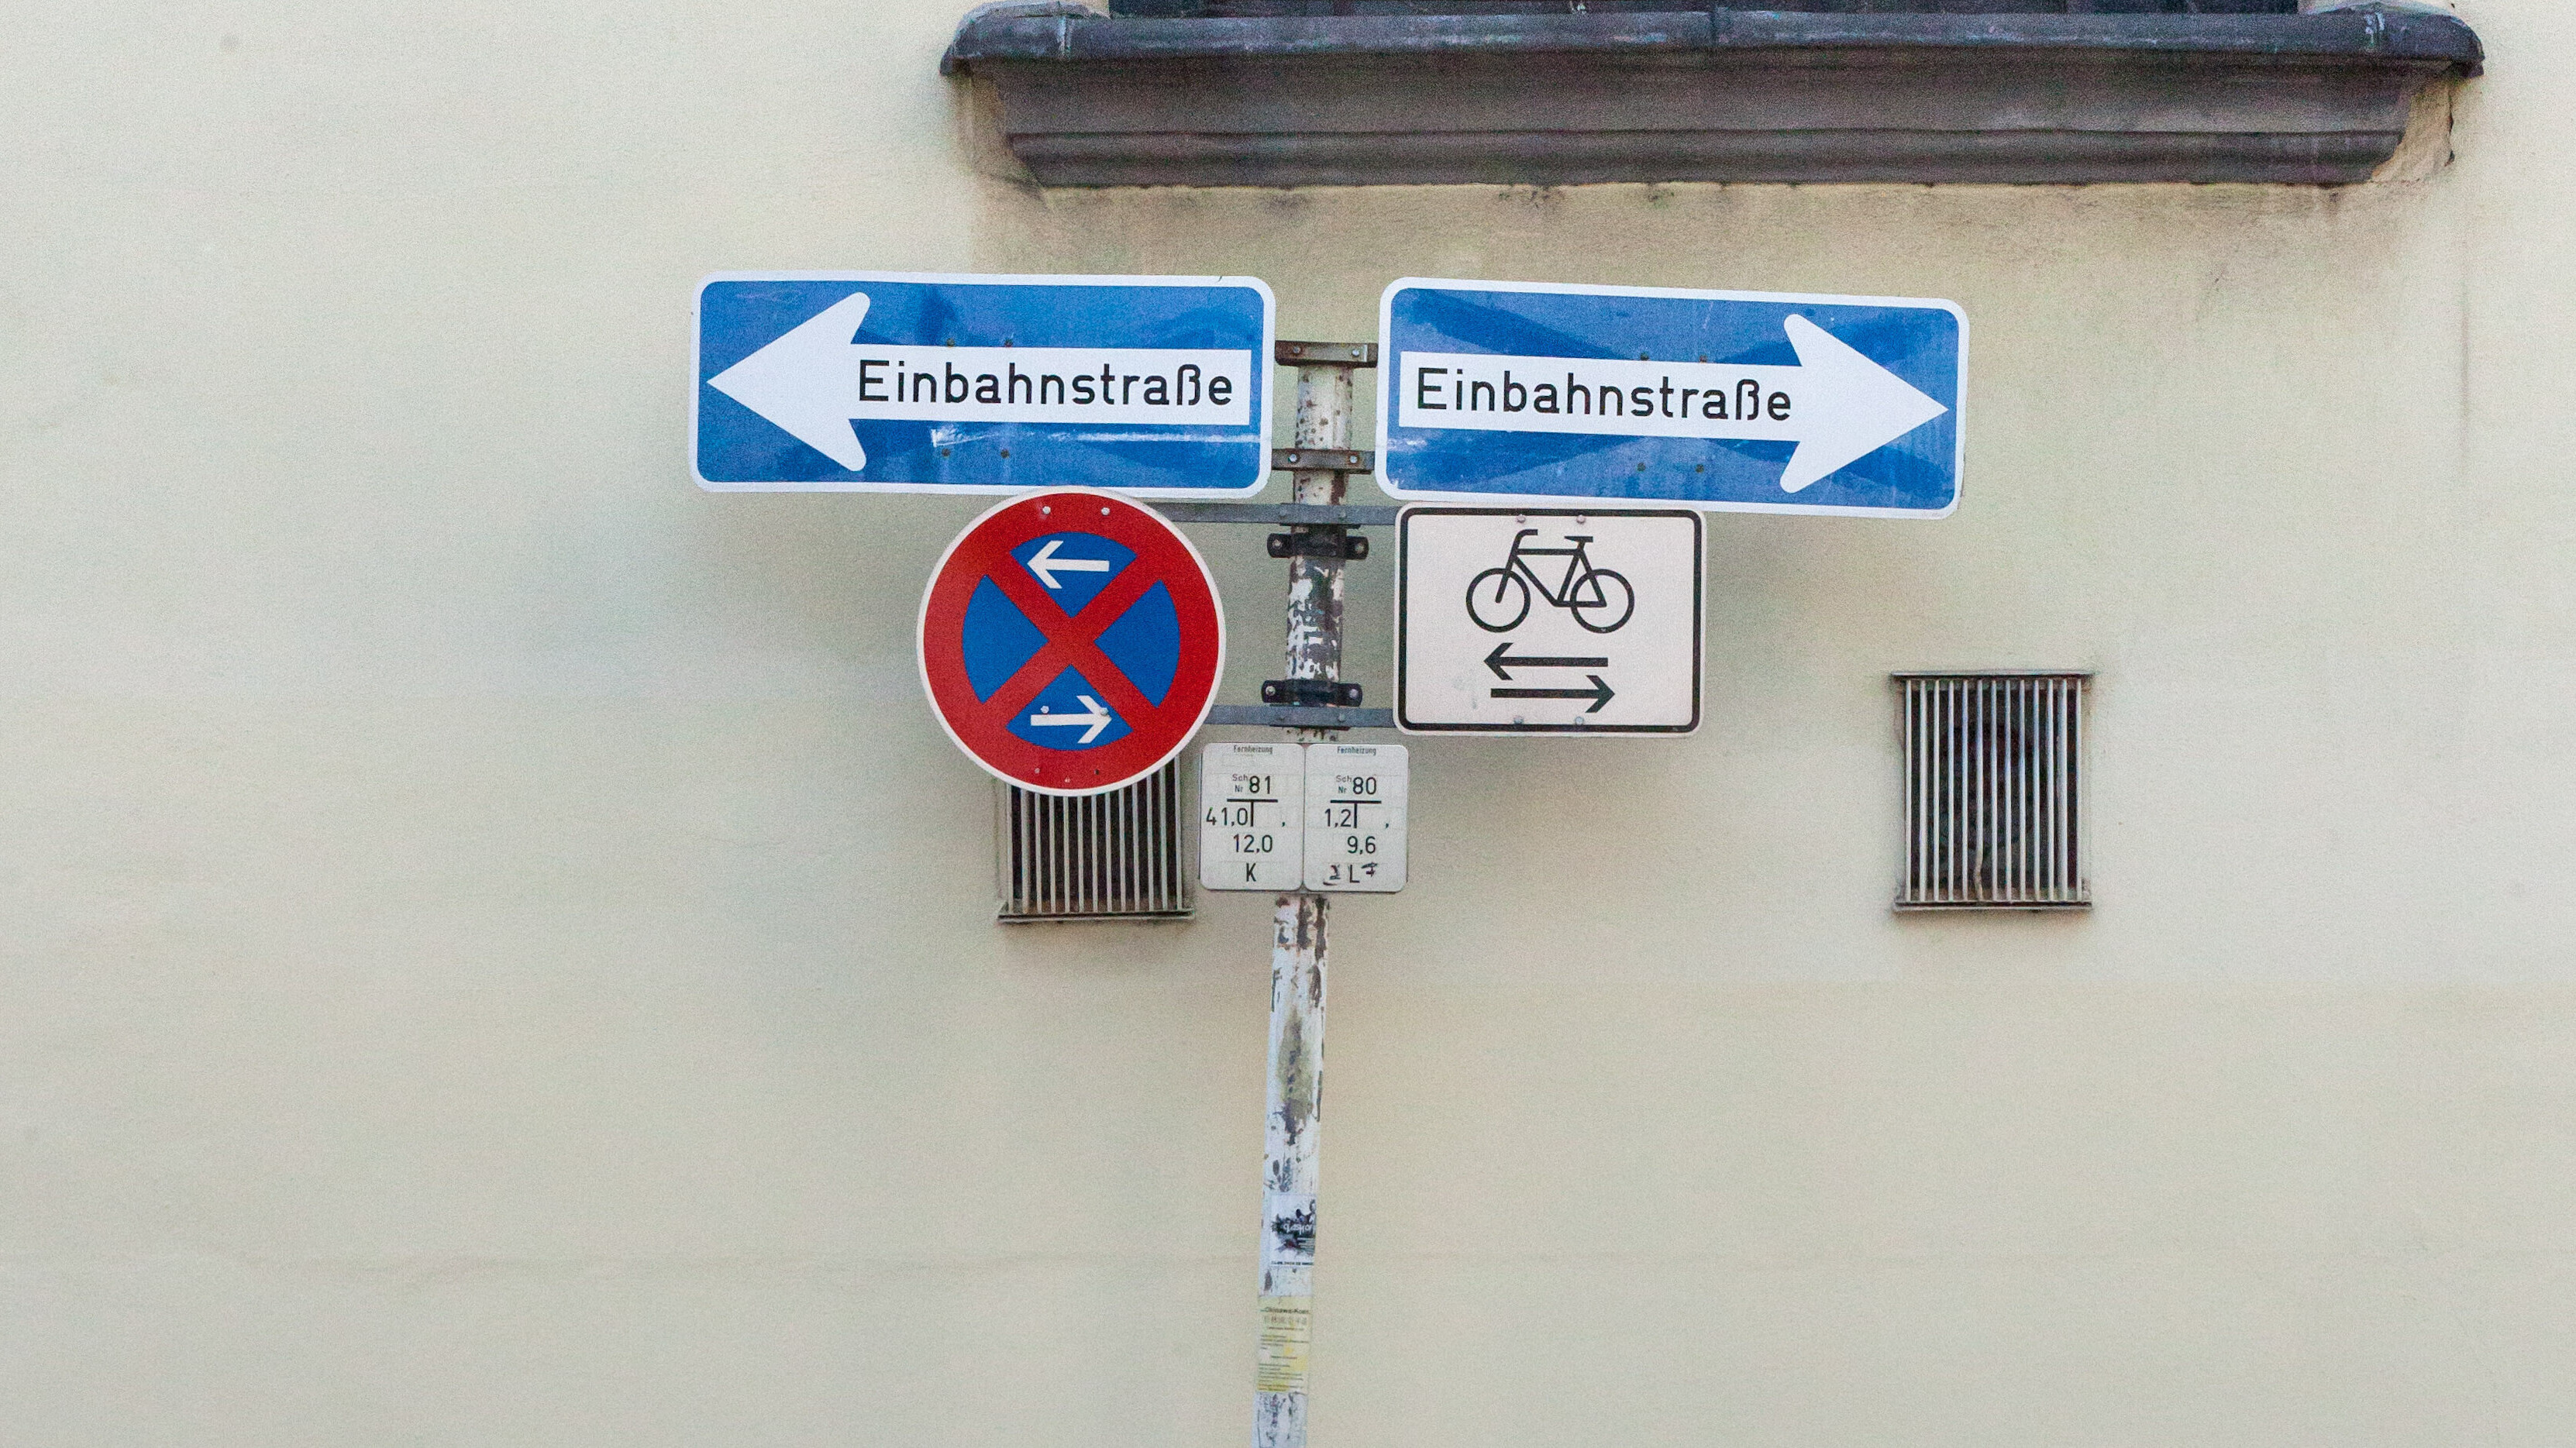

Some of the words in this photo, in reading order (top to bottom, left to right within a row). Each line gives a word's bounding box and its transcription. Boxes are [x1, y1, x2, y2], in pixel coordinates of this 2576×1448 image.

[859, 359, 1232, 407] Einbahnstraße
[1417, 366, 1793, 421] Einbahnstraße
[1234, 745, 1273, 755] Fernheizung
[1337, 746, 1376, 756] Fernheizung
[1248, 775, 1272, 795] 81
[1352, 776, 1377, 795] 80
[1206, 807, 1248, 827] 41,0
[1324, 808, 1352, 828] 1,2
[1246, 862, 1257, 882] K
